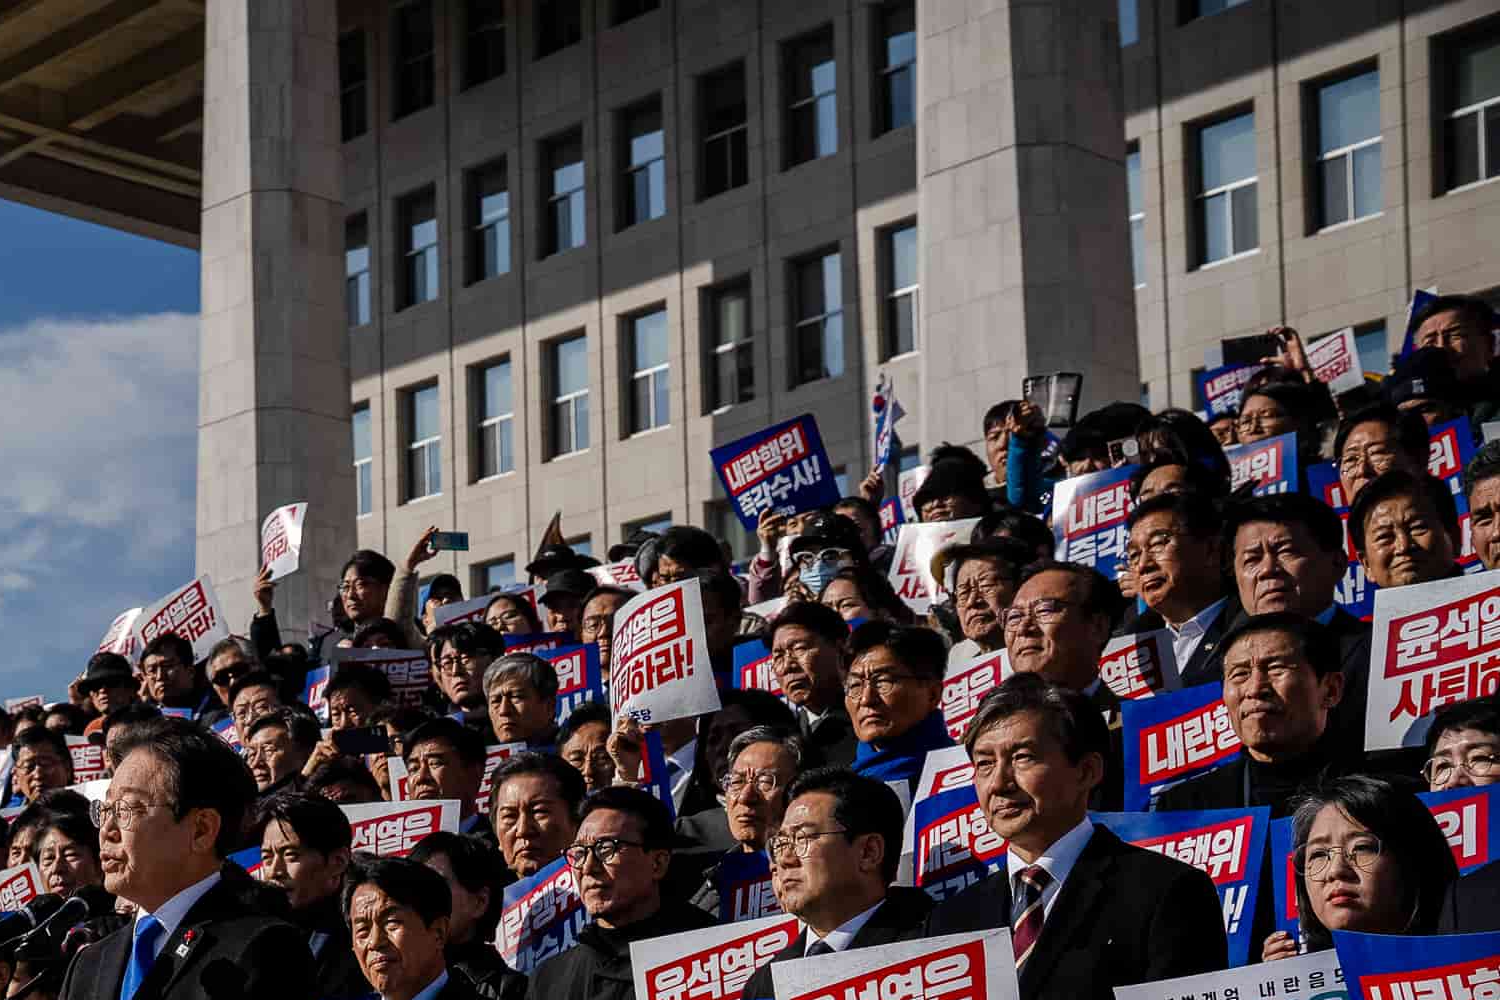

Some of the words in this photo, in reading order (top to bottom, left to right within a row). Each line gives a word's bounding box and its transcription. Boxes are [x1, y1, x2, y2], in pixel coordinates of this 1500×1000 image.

[725, 427, 804, 490] 내란행위
[737, 455, 822, 517] 즉각수사!
[1068, 485, 1136, 533] 내란
[1148, 702, 1242, 776] 내란행
[351, 811, 434, 856] 석열은
[918, 806, 1005, 878] 내란행
[503, 869, 581, 950] 란행위
